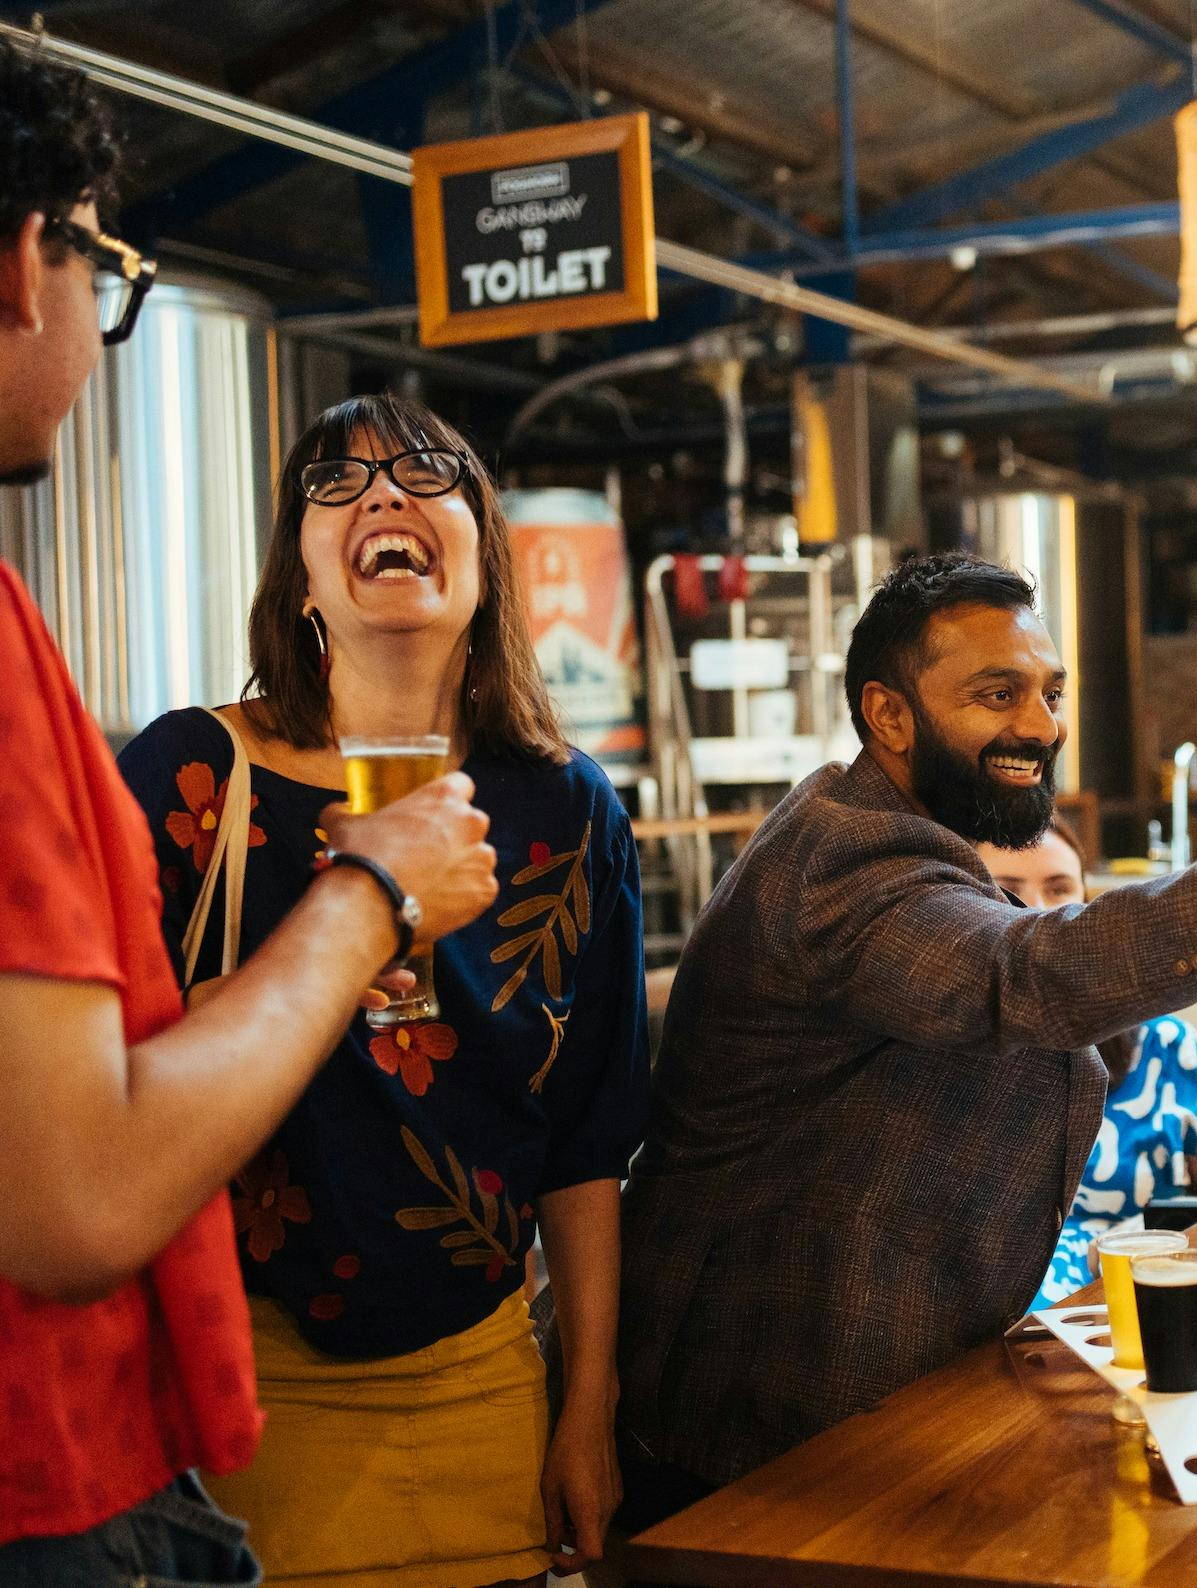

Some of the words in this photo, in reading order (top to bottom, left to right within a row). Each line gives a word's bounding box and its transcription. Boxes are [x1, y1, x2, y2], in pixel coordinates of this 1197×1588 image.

[476, 193, 588, 235] GANGWAY
[519, 227, 547, 253] TO
[462, 245, 611, 306] TOILET
